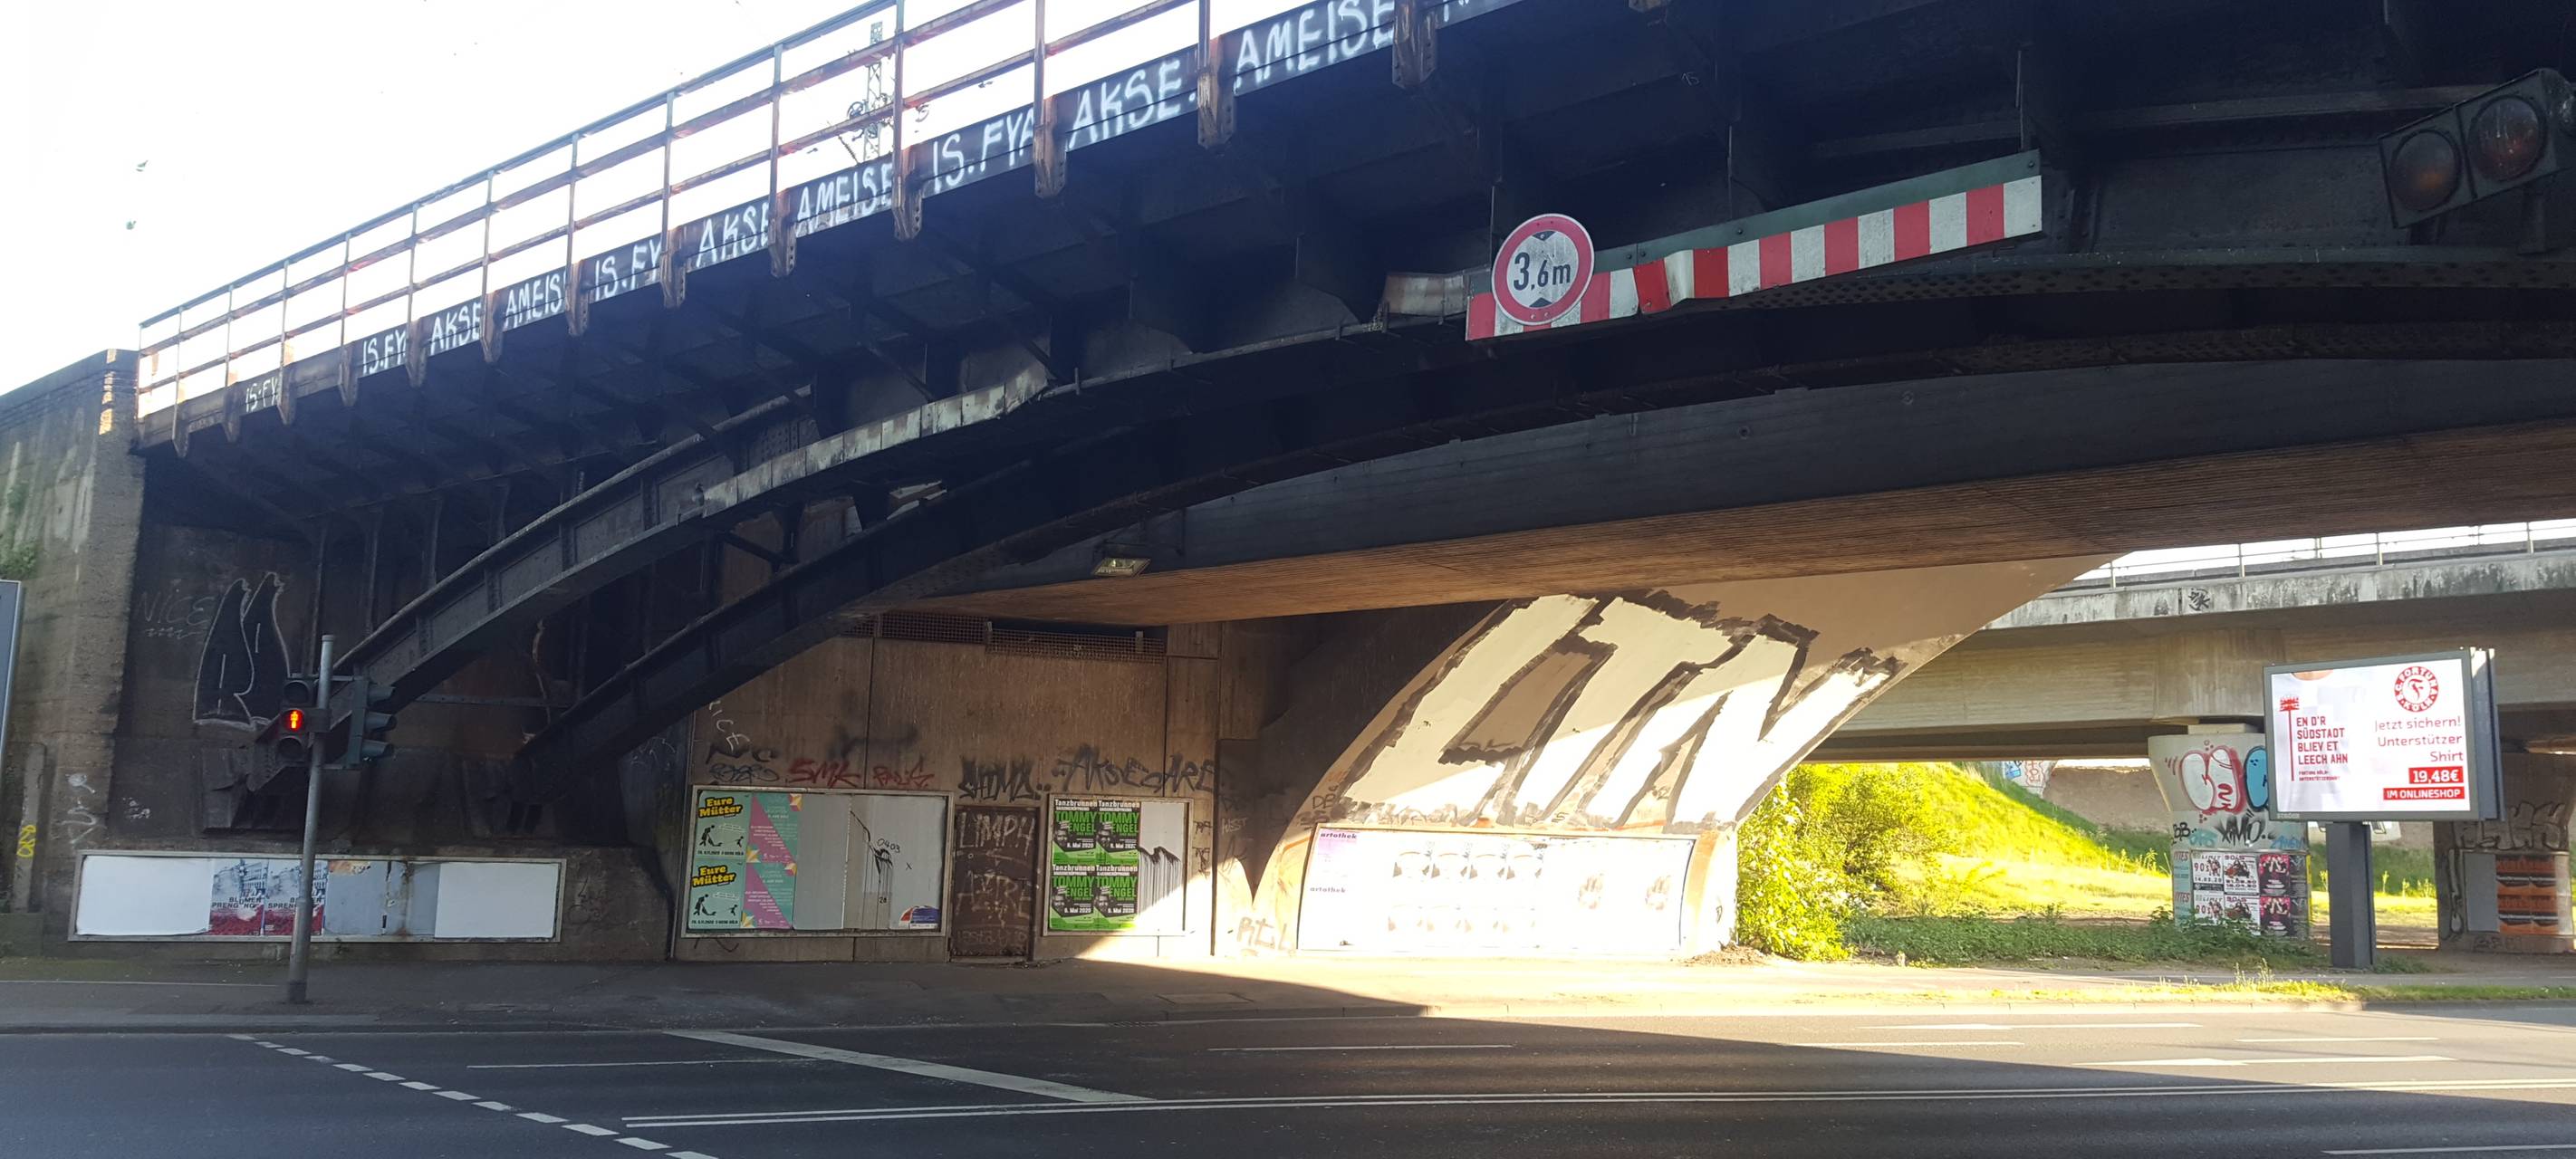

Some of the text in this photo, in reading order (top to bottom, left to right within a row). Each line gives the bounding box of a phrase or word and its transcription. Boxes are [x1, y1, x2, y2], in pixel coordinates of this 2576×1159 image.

[504, 270, 566, 329] AMEIS
[796, 163, 893, 237] AMEISE
[1233, 0, 1395, 92] AMEISE
[2297, 717, 2308, 727] EN
[2375, 716, 2461, 732] Jetzt sichern!
[2297, 727, 2345, 740] SÜDSTADT
[2378, 734, 2463, 747] Unterstützer
[2298, 742, 2339, 752] BLIEV ET
[2298, 753, 2348, 765] LEECH AHN
[2430, 750, 2464, 762] Shirt
[2413, 770, 2459, 783] 19,48€
[2387, 789, 2461, 799] IM ONLINESHOP
[698, 805, 743, 818] Mütter
[1055, 811, 1097, 822] TOMMY
[1098, 812, 1139, 823] TOMMY
[1069, 823, 1096, 832] ENGEL
[1112, 823, 1138, 832] ENGEL
[692, 872, 736, 886] Mütter
[1053, 876, 1094, 886] TOMMY
[1096, 876, 1137, 886] TOMMY
[1065, 888, 1093, 896] ENGEL
[1110, 888, 1137, 896] ENGEL
